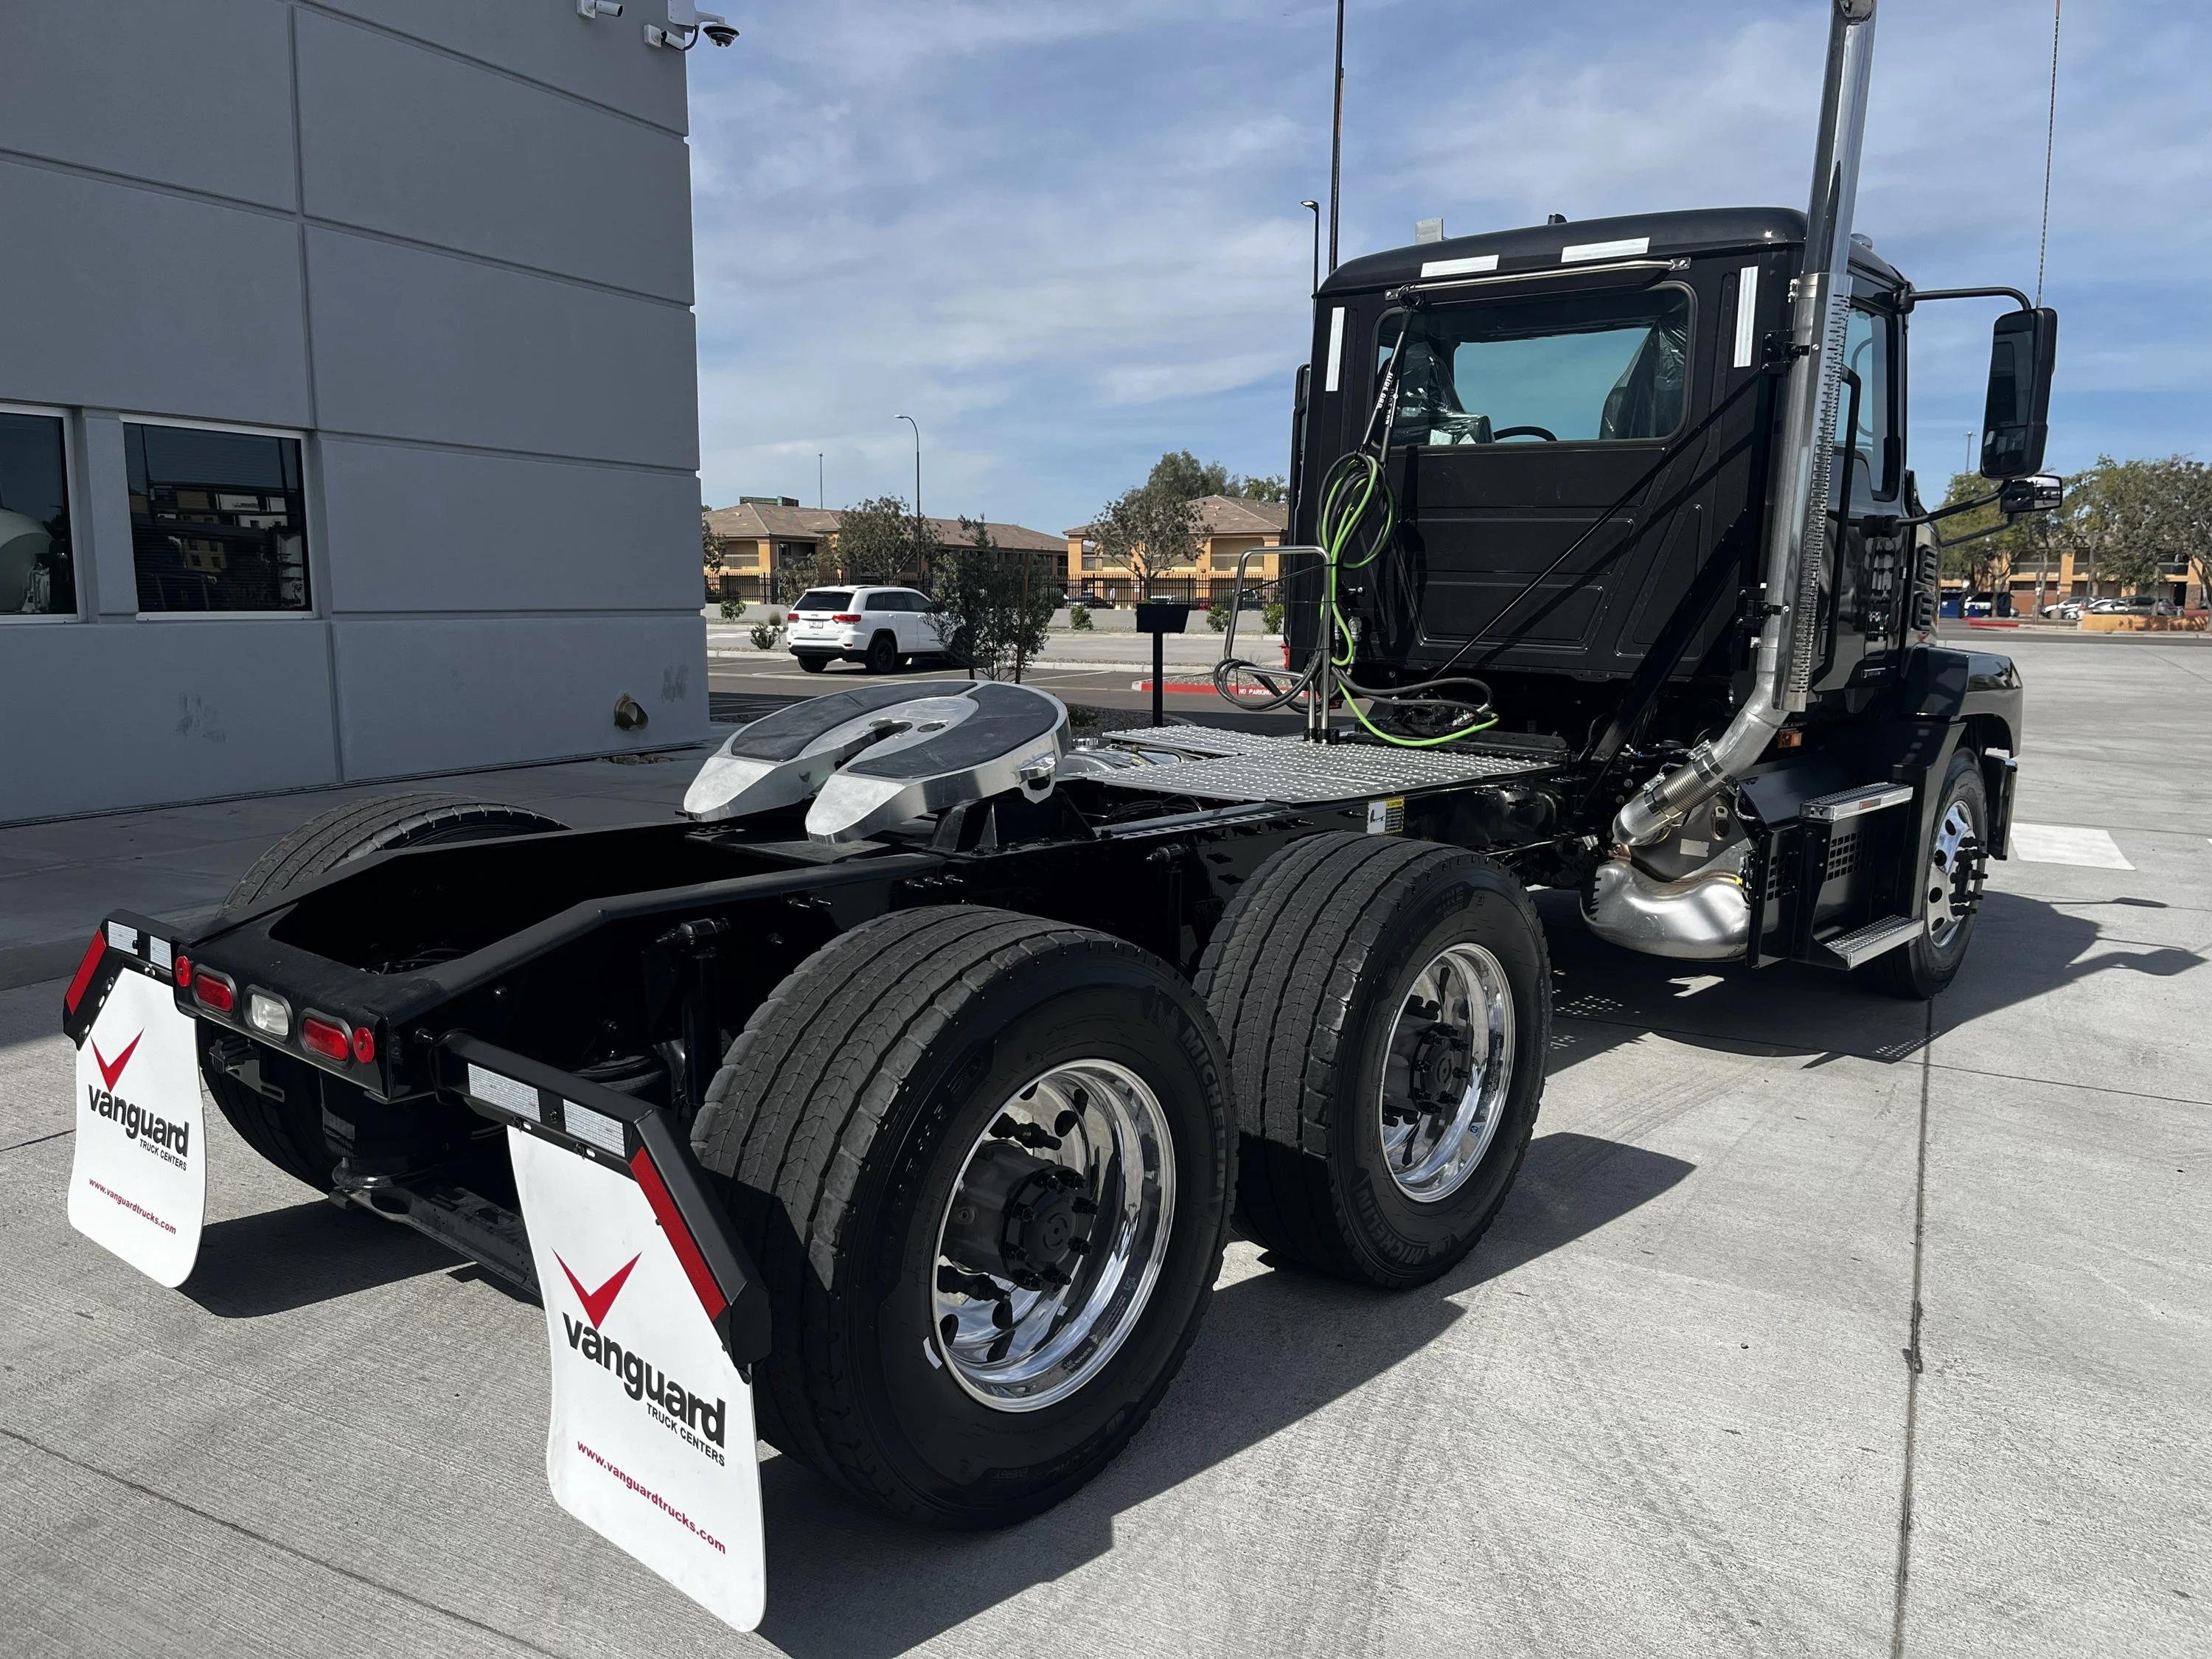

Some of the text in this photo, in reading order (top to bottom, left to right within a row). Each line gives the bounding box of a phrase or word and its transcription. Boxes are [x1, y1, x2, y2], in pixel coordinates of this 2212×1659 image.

[88, 1084, 189, 1158] vanguard
[1180, 1024, 1227, 1192] MICHELIN
[139, 1138, 187, 1172] TRUCK CENTERS
[88, 1178, 176, 1235] www.vanguardtrucks.com
[1355, 1188, 1427, 1265] MICHELIN
[562, 1312, 726, 1449] vanguard
[647, 1402, 725, 1467] TRUCK CENTERS
[577, 1440, 726, 1554] www.vanguardtrucks.com
